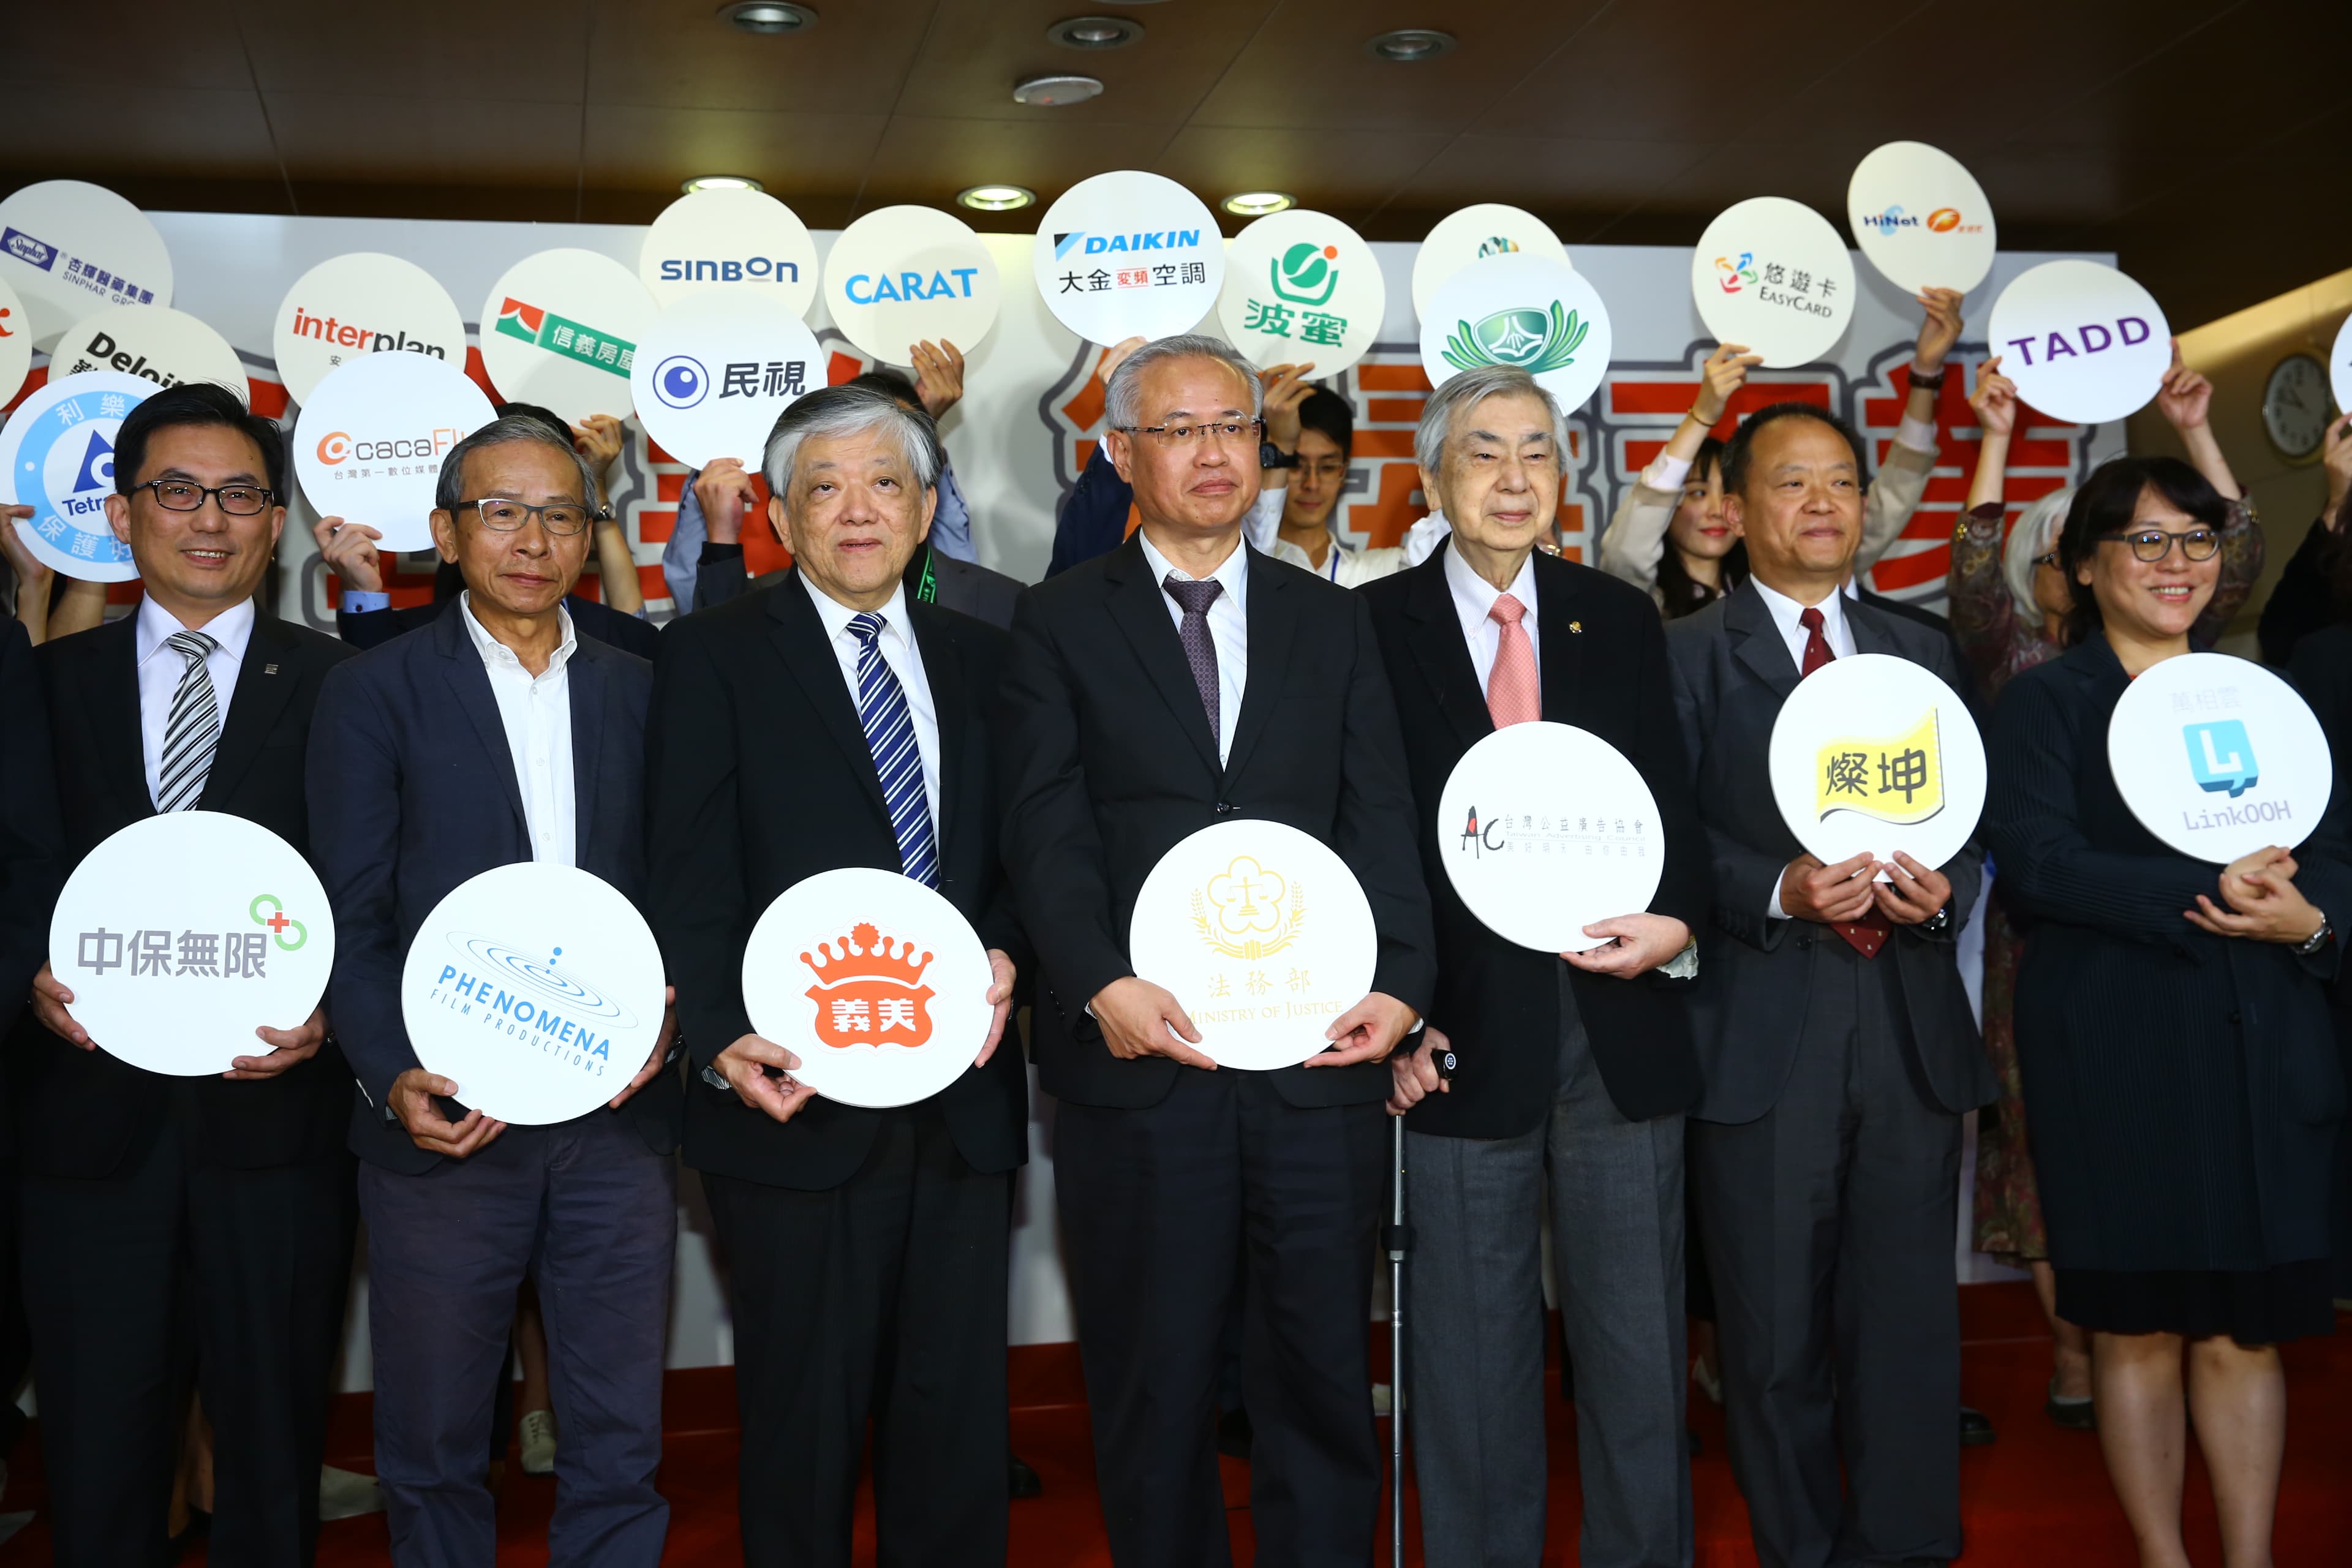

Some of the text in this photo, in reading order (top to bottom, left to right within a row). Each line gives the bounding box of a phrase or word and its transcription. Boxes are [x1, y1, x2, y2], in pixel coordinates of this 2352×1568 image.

[11, 239, 45, 260] Sinphar
[1085, 230, 1200, 254] DAIKIN
[62, 271, 106, 296] SINPHAR
[68, 257, 154, 305] 杏輝醫藥集團
[845, 268, 978, 305] CARAT
[1765, 262, 1837, 298] 悠遊卡
[1244, 298, 1348, 347] 波蜜
[552, 325, 634, 371] 信義房屋
[2008, 317, 2150, 366] TADD
[719, 361, 805, 399] 民視
[334, 464, 438, 480] 台灣第一數位媒體
[62, 496, 107, 516] Tetr
[1826, 748, 1926, 804] 燦坤
[1504, 813, 1644, 834] 台灣公益廣告協會
[2183, 800, 2292, 831] LinkOOH
[1546, 832, 1601, 841] Advertising
[78, 927, 267, 979] 中保無限
[1207, 967, 1311, 998] 法務部
[438, 965, 610, 1061] PHENOMENA
[831, 998, 916, 1032] 義美
[431, 989, 604, 1076] FILM PRODUCTIONS
